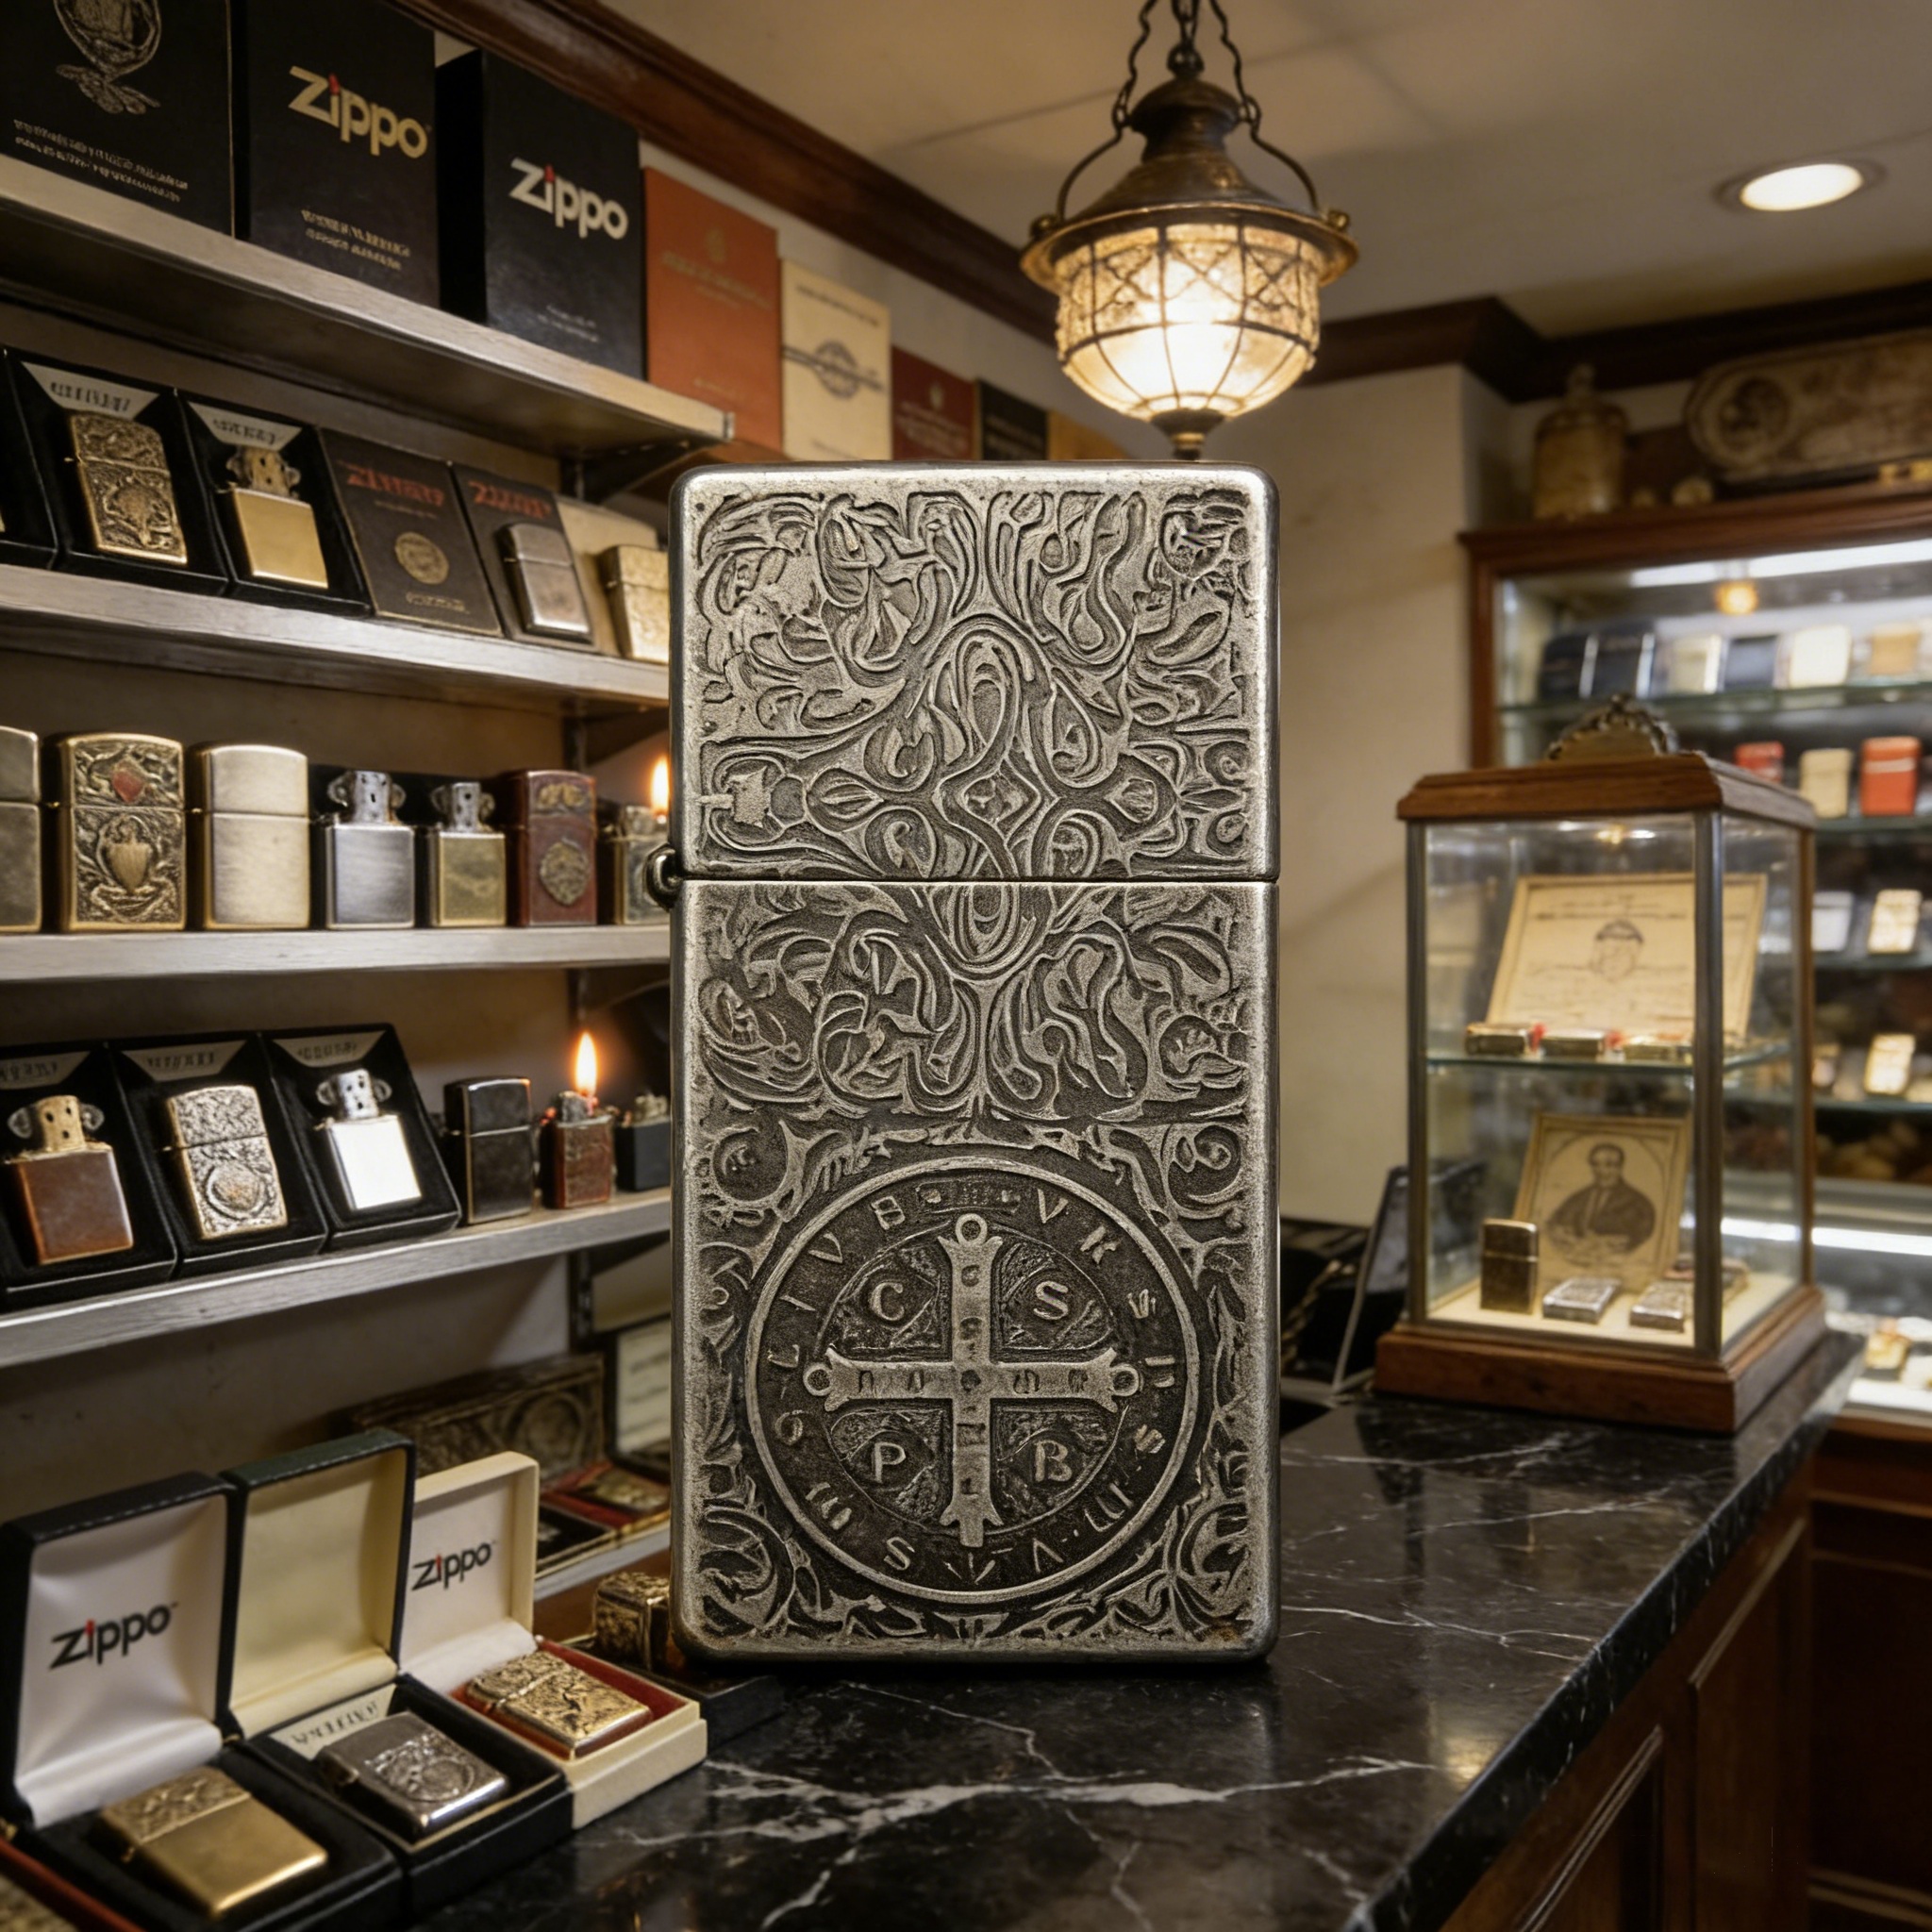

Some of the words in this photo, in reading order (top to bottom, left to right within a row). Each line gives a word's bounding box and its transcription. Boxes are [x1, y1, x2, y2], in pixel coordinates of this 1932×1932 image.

[289, 66, 427, 158] Zippo
[508, 158, 629, 239] Zippo
[870, 1281, 906, 1321] C
[1034, 1281, 1070, 1320] S
[874, 1441, 907, 1484] P
[1035, 1440, 1073, 1482] B
[411, 1542, 491, 1591] Zippo
[49, 1605, 172, 1670] Zippo
